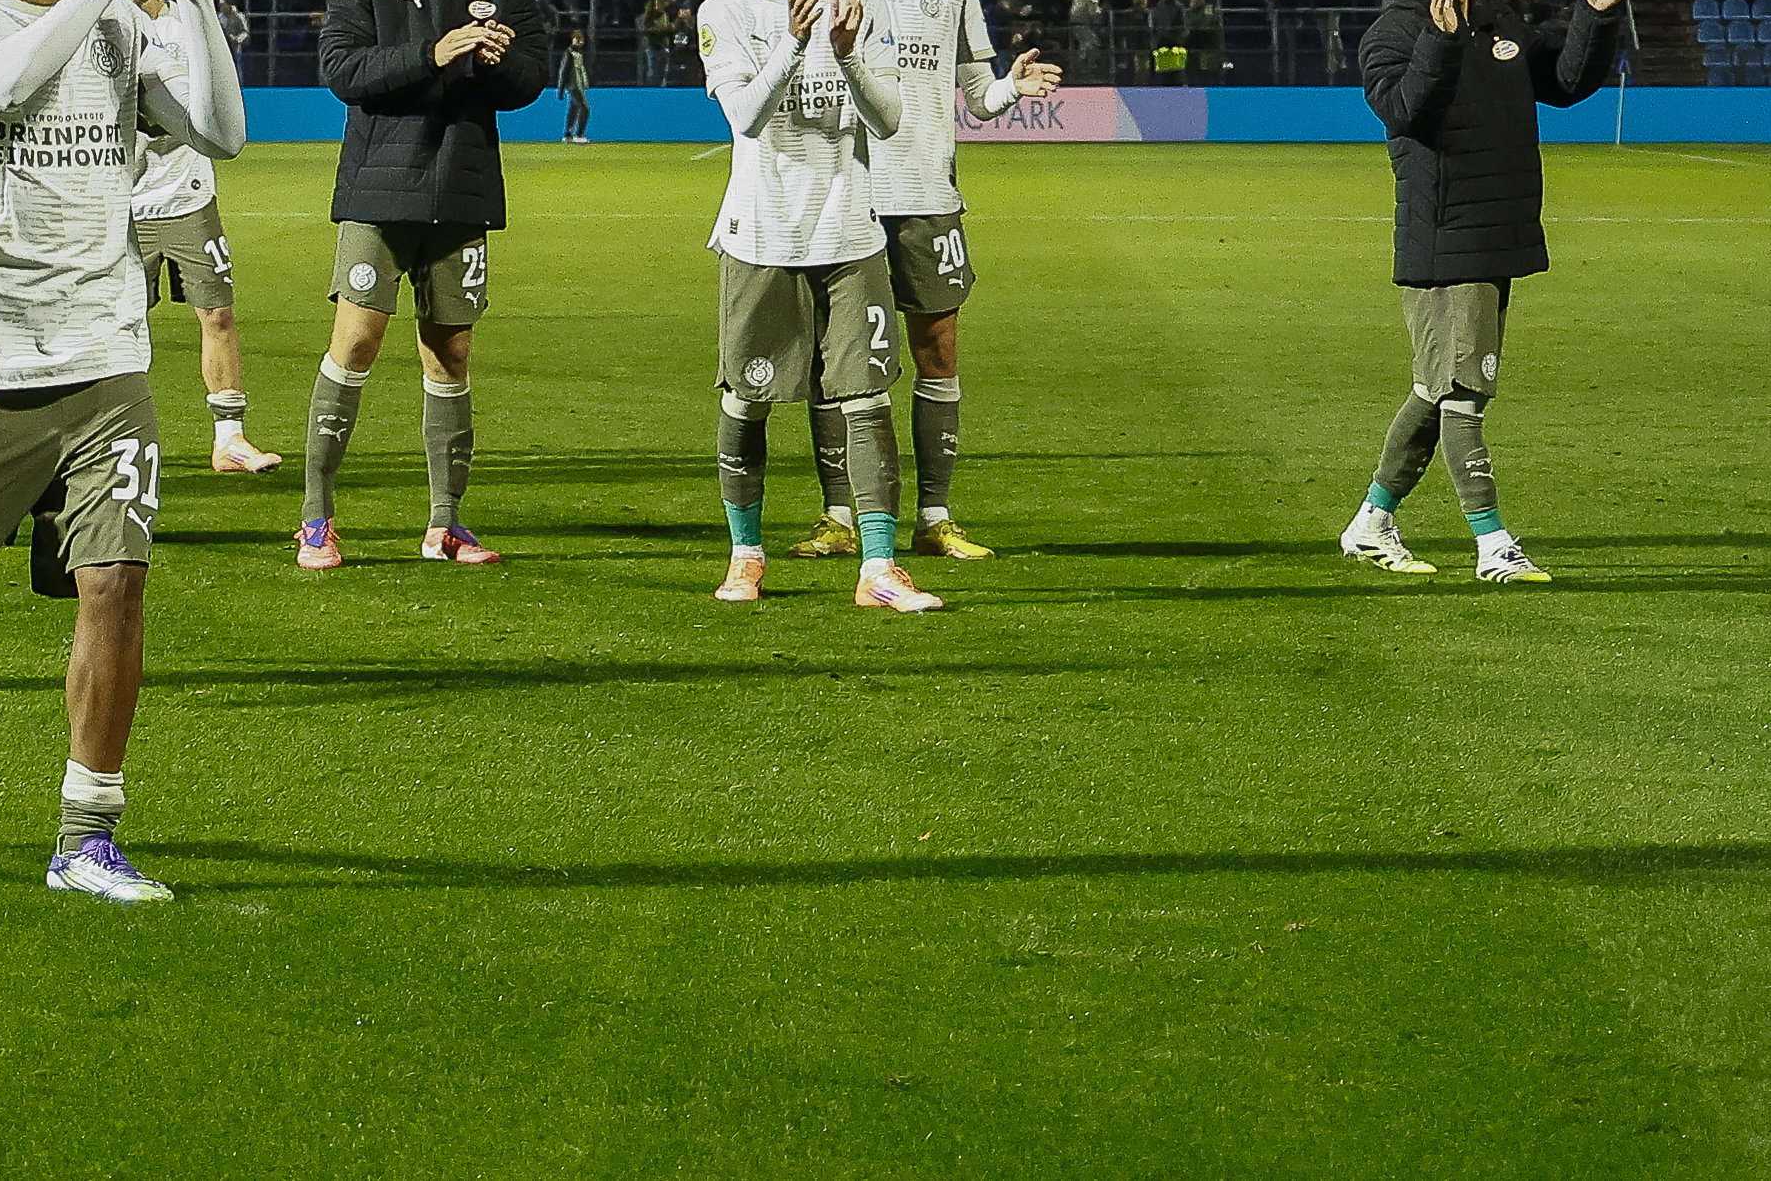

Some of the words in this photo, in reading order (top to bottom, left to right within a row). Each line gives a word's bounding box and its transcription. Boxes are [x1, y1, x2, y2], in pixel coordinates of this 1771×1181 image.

[789, 79, 847, 97] INPOR
[933, 228, 966, 276] 20
[866, 305, 890, 350] 2
[111, 438, 160, 511] 31
